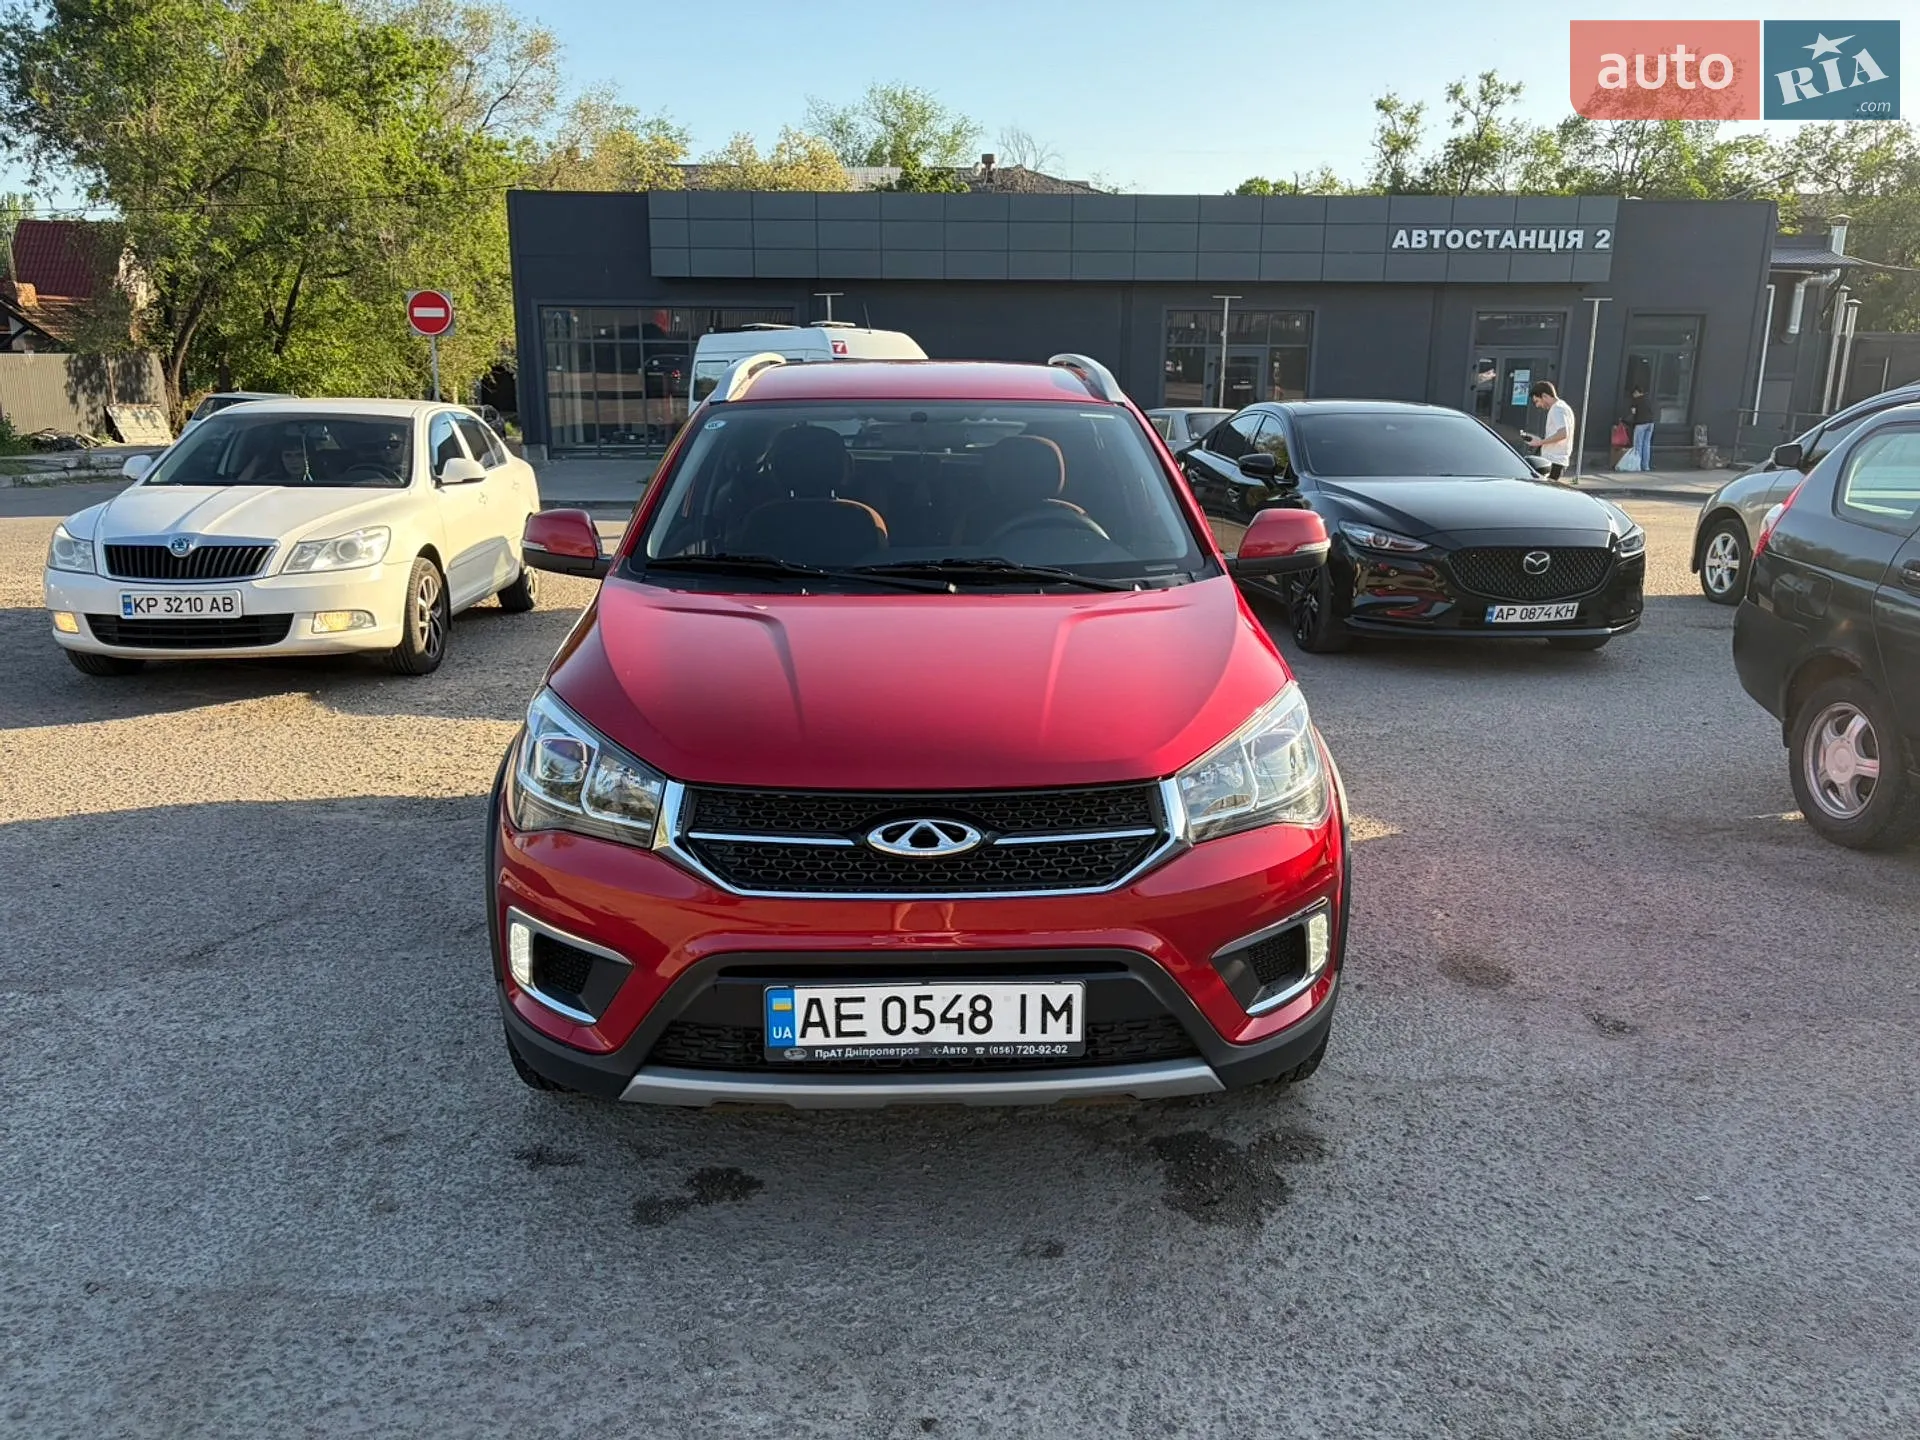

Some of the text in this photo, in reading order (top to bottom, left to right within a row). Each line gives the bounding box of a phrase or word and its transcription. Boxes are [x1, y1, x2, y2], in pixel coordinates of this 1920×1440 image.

[1392, 229, 1612, 252] АВТОСТАНЦІЯ 2
[133, 597, 159, 613] KP
[164, 597, 204, 613] 3210
[209, 596, 234, 612] AB
[1494, 608, 1516, 621] AP
[1519, 607, 1552, 620] 0874
[1554, 605, 1576, 618] KH
[799, 993, 1074, 1039] AE 0548 IM
[773, 1027, 793, 1039] UA
[814, 1049, 843, 1059] ПрАТ
[1016, 1044, 1068, 1055] 720-92-02
